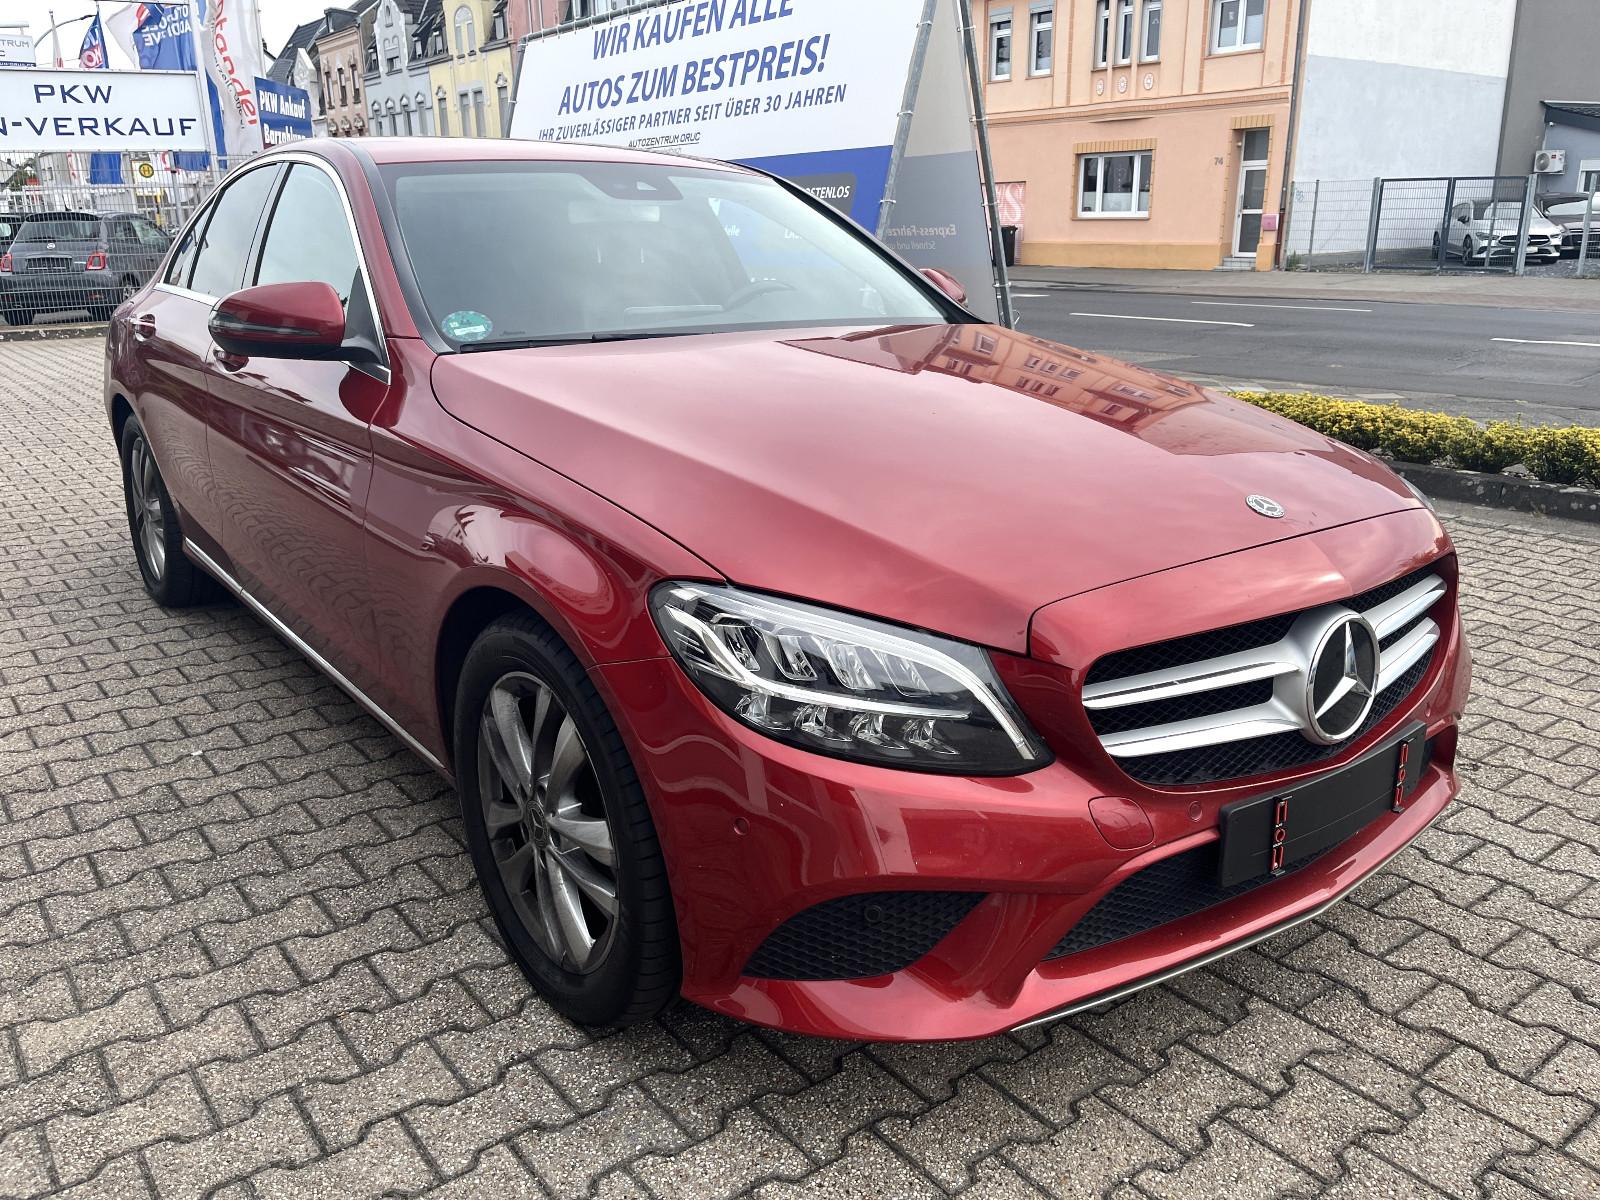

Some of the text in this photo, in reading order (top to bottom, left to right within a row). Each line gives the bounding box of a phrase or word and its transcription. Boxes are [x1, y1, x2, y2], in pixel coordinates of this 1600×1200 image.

[593, 0, 793, 60] WIR KAUFEN ALLE
[558, 34, 830, 116] AUTOS ZUM BESTPREIS!
[34, 84, 112, 104] PKW
[259, 90, 278, 114] PKW
[539, 83, 847, 141] IHR ZUVERLÄSSIGER PARTNER SEIT ÜBER 30 JAHREN
[264, 123, 306, 145] Barzahl
[1214, 156, 1224, 166] 74
[803, 185, 851, 199] STENLOS
